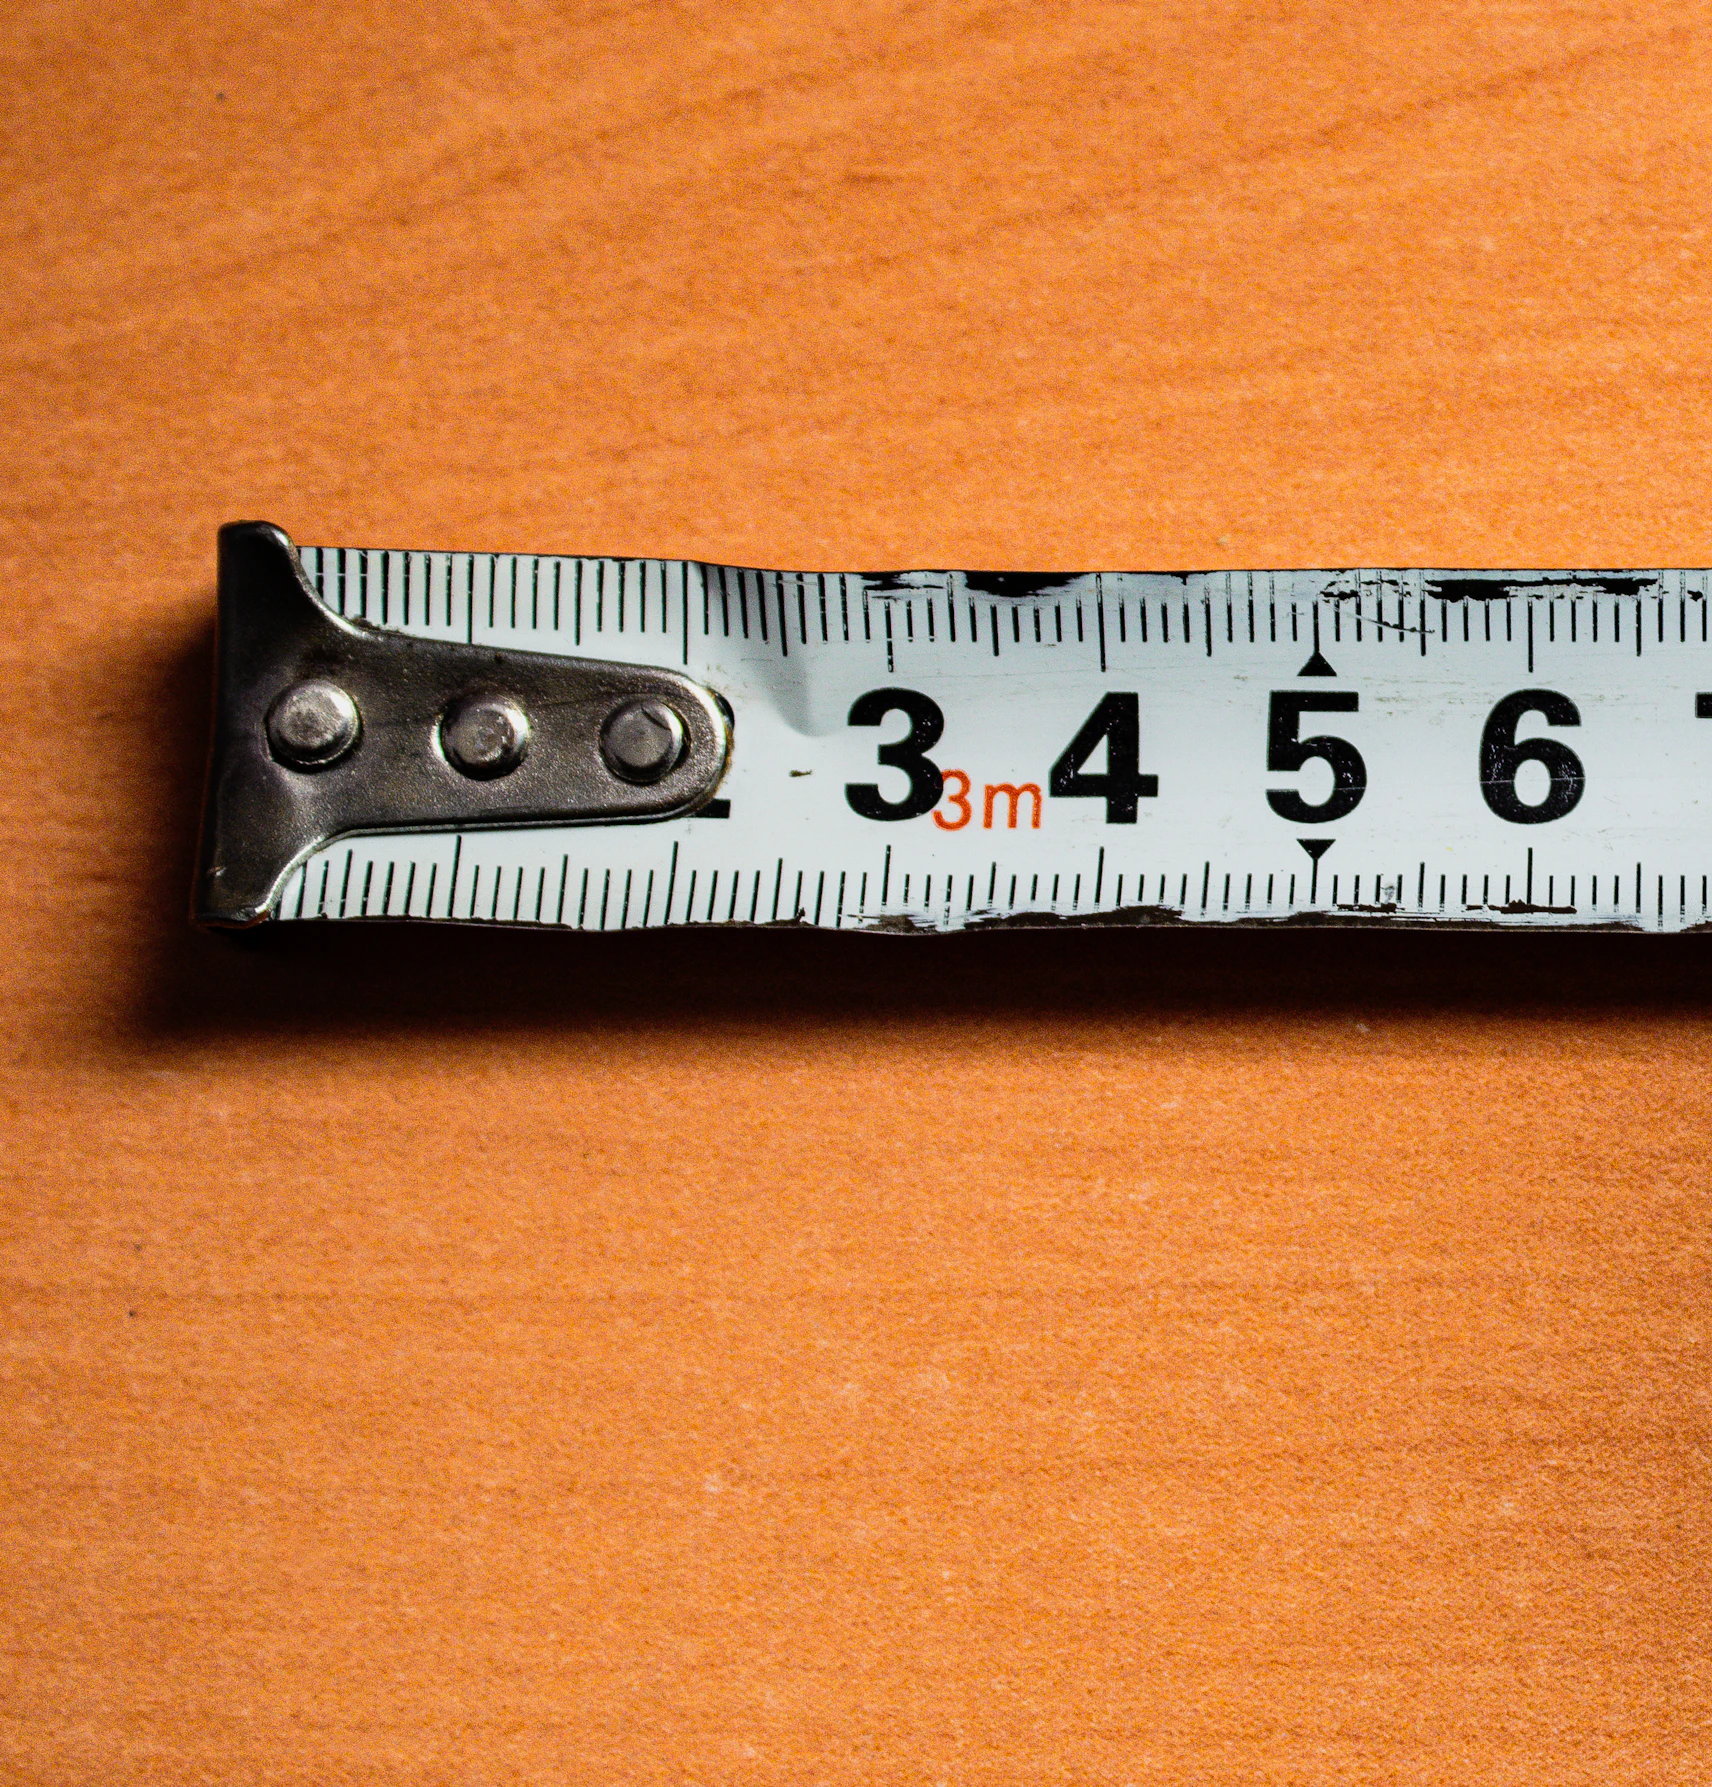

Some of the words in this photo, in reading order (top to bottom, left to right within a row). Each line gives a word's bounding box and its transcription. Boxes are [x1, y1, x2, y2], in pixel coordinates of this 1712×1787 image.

[845, 687, 945, 822] 3
[1049, 692, 1159, 825] 4
[1266, 690, 1367, 824] 5
[1479, 688, 1585, 825] 6
[931, 768, 1043, 831] 3m
